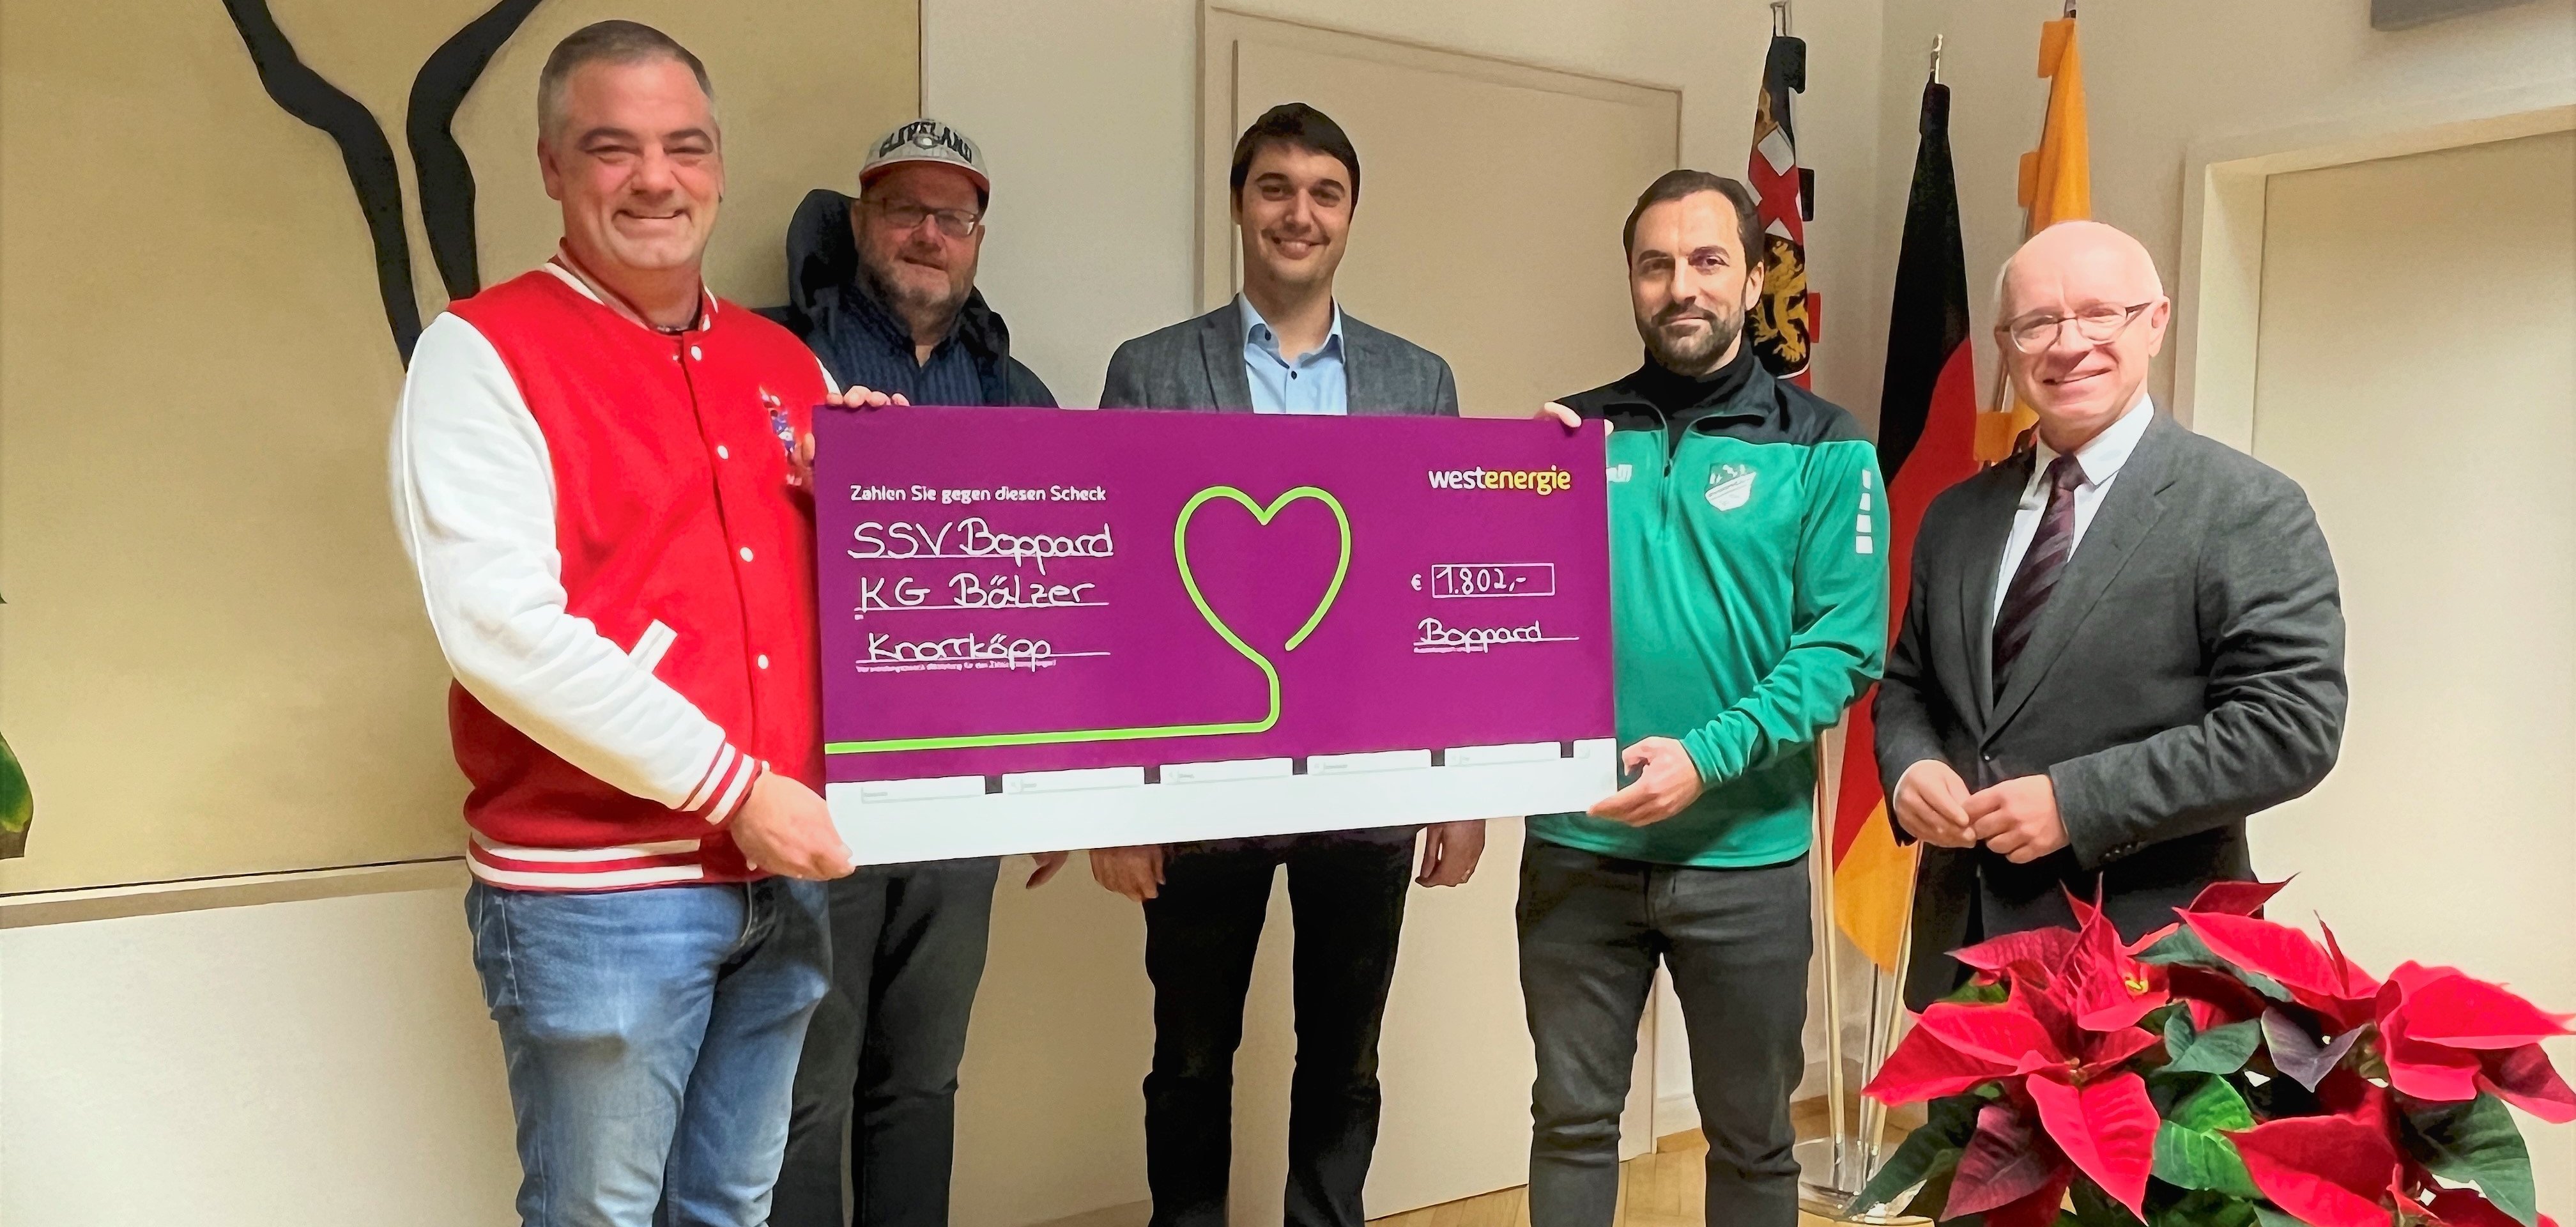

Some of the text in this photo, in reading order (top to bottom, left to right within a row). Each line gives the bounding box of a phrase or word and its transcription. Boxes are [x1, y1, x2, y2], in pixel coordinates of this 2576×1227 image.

[850, 485, 1107, 504] Zahlen Sie gegen diesen Scheck
[1428, 465, 1571, 495] westenergie
[848, 517, 1114, 576] SSV Boppard
[861, 576, 931, 612] KG
[1418, 617, 1542, 653] Boppard
